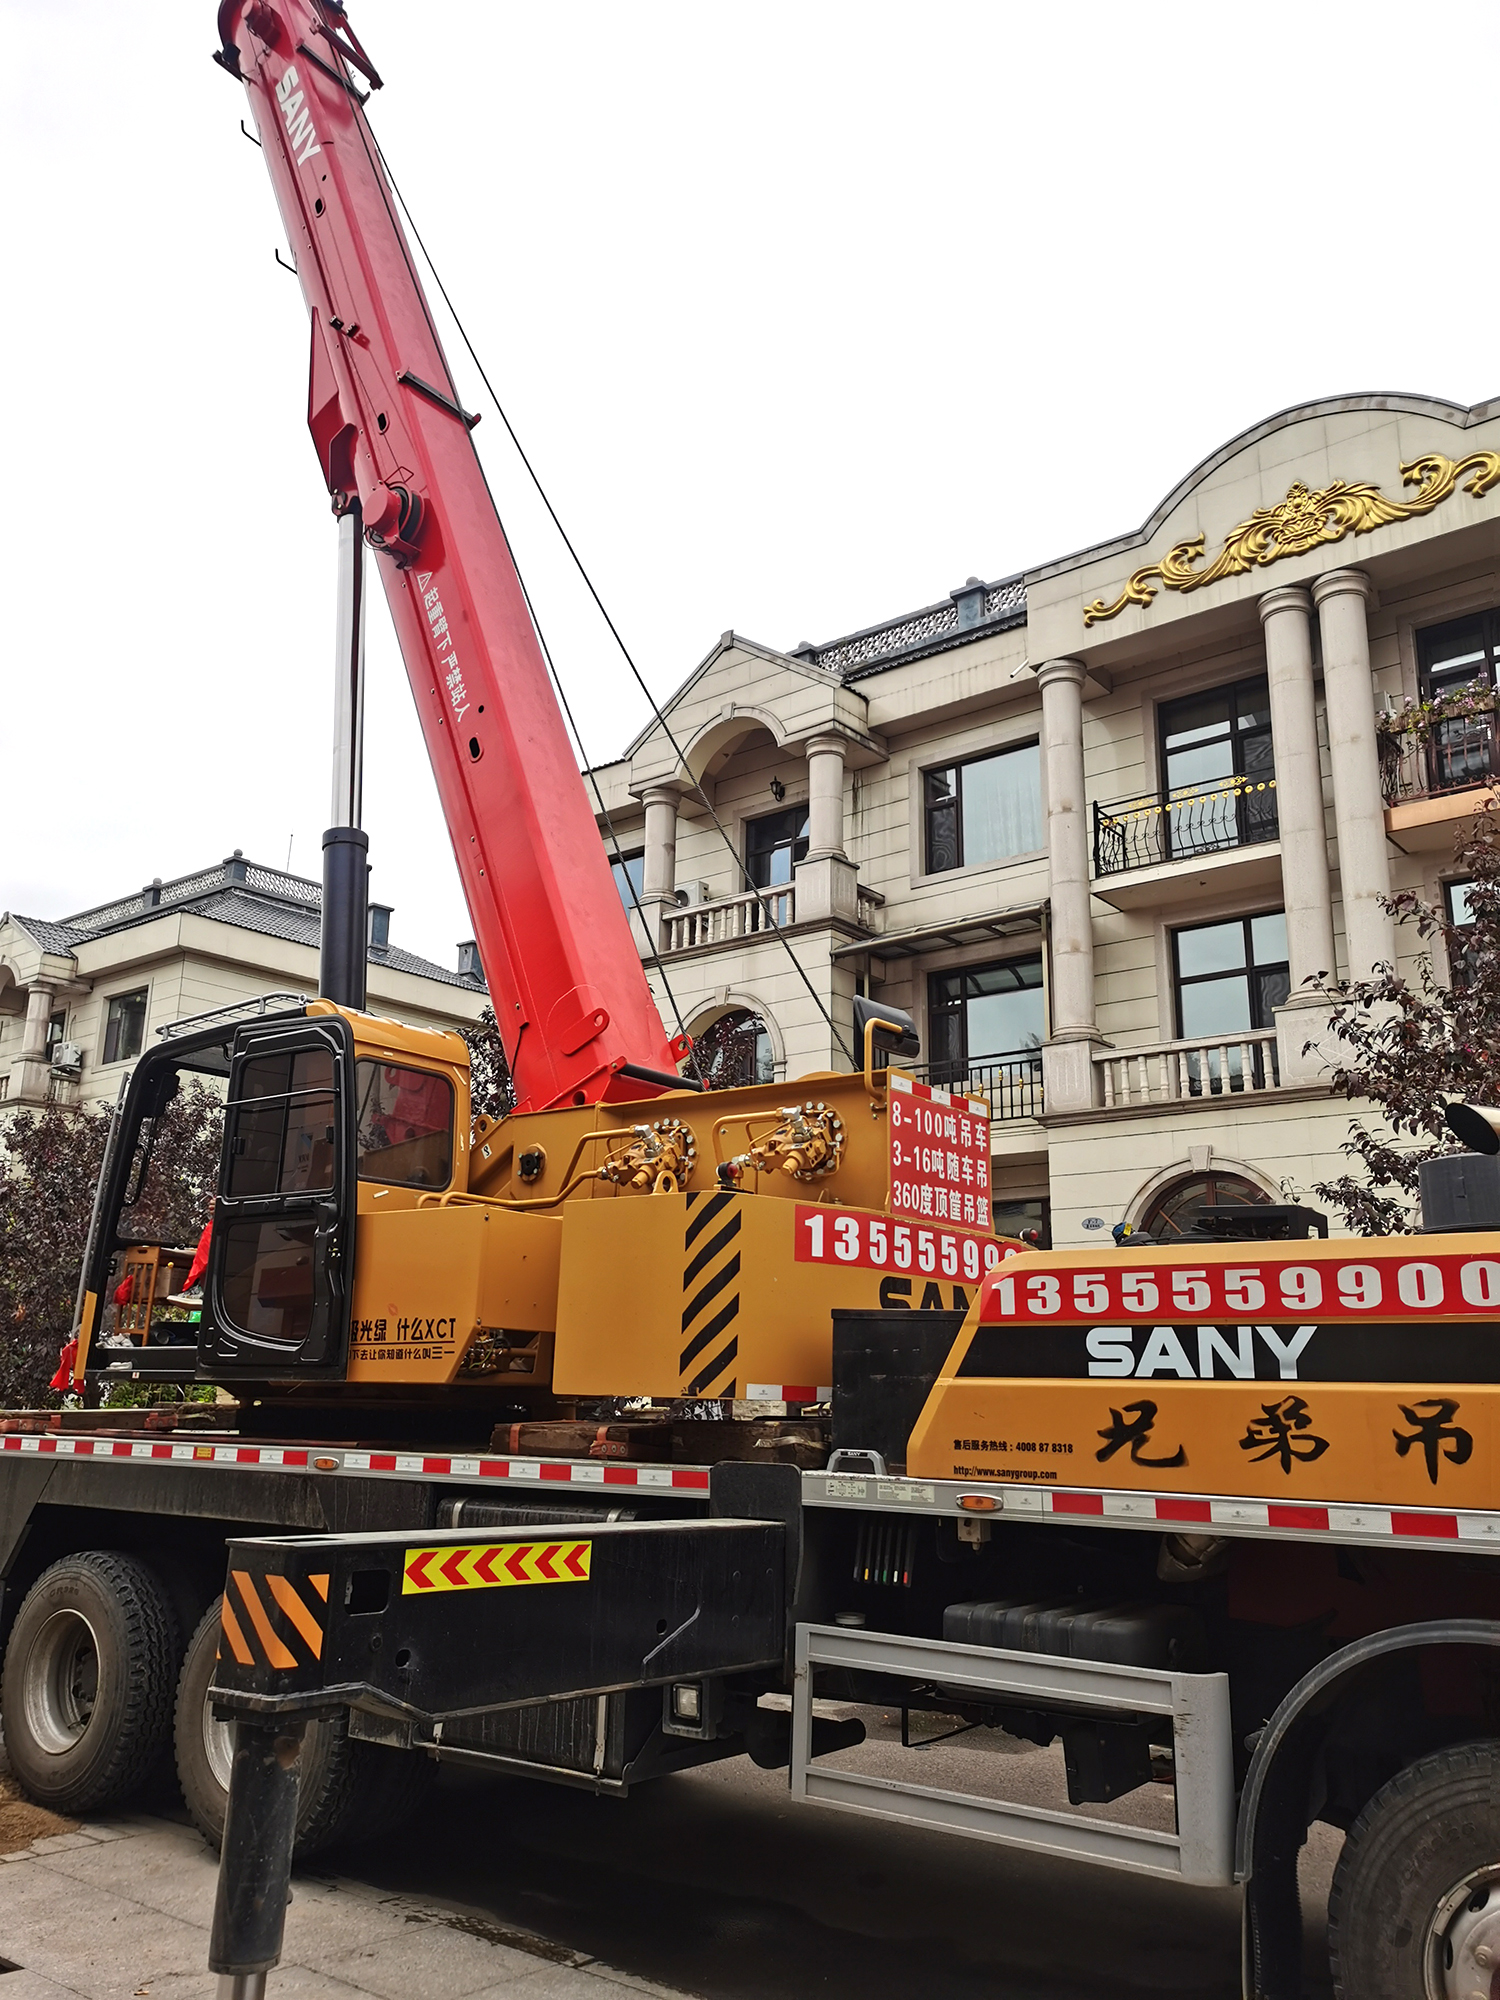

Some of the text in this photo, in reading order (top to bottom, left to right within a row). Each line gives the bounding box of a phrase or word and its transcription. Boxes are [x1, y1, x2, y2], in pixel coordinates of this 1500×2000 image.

[275, 66, 321, 167] SANY
[424, 587, 470, 723] 起重臂下 严禁站人
[892, 1101, 987, 1153] 8-100吨吊车
[892, 1140, 988, 1188] 3-16吨随车吊
[804, 1214, 1017, 1279] 13555599
[397, 1317, 456, 1341] 什么XCT
[1086, 1326, 1318, 1379] SANY
[953, 1465, 1058, 1480] http://www.sanygroup.com
[1016, 1442, 1037, 1453] 4008
[1039, 1442, 1049, 1453] 87
[1052, 1443, 1074, 1454] 8318
